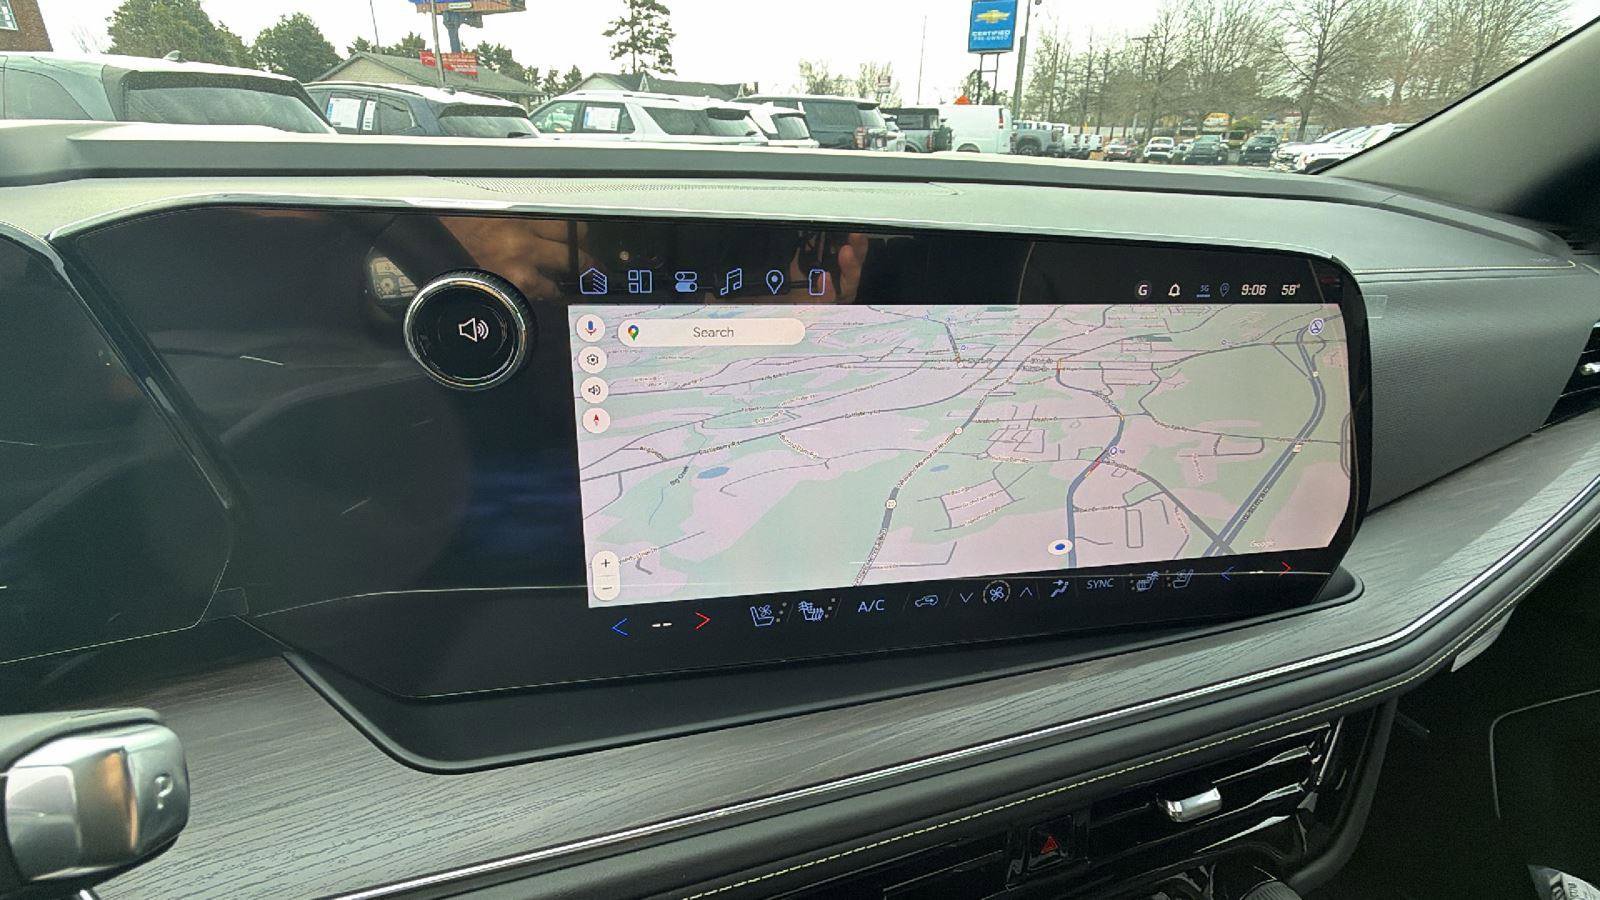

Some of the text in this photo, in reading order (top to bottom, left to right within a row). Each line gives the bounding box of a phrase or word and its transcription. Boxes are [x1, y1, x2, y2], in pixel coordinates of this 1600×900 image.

[1138, 284, 1148, 296] G
[1241, 284, 1268, 296] 9:06
[692, 326, 734, 338] Search
[1086, 578, 1114, 590] SYNC
[857, 599, 885, 614] A/C
